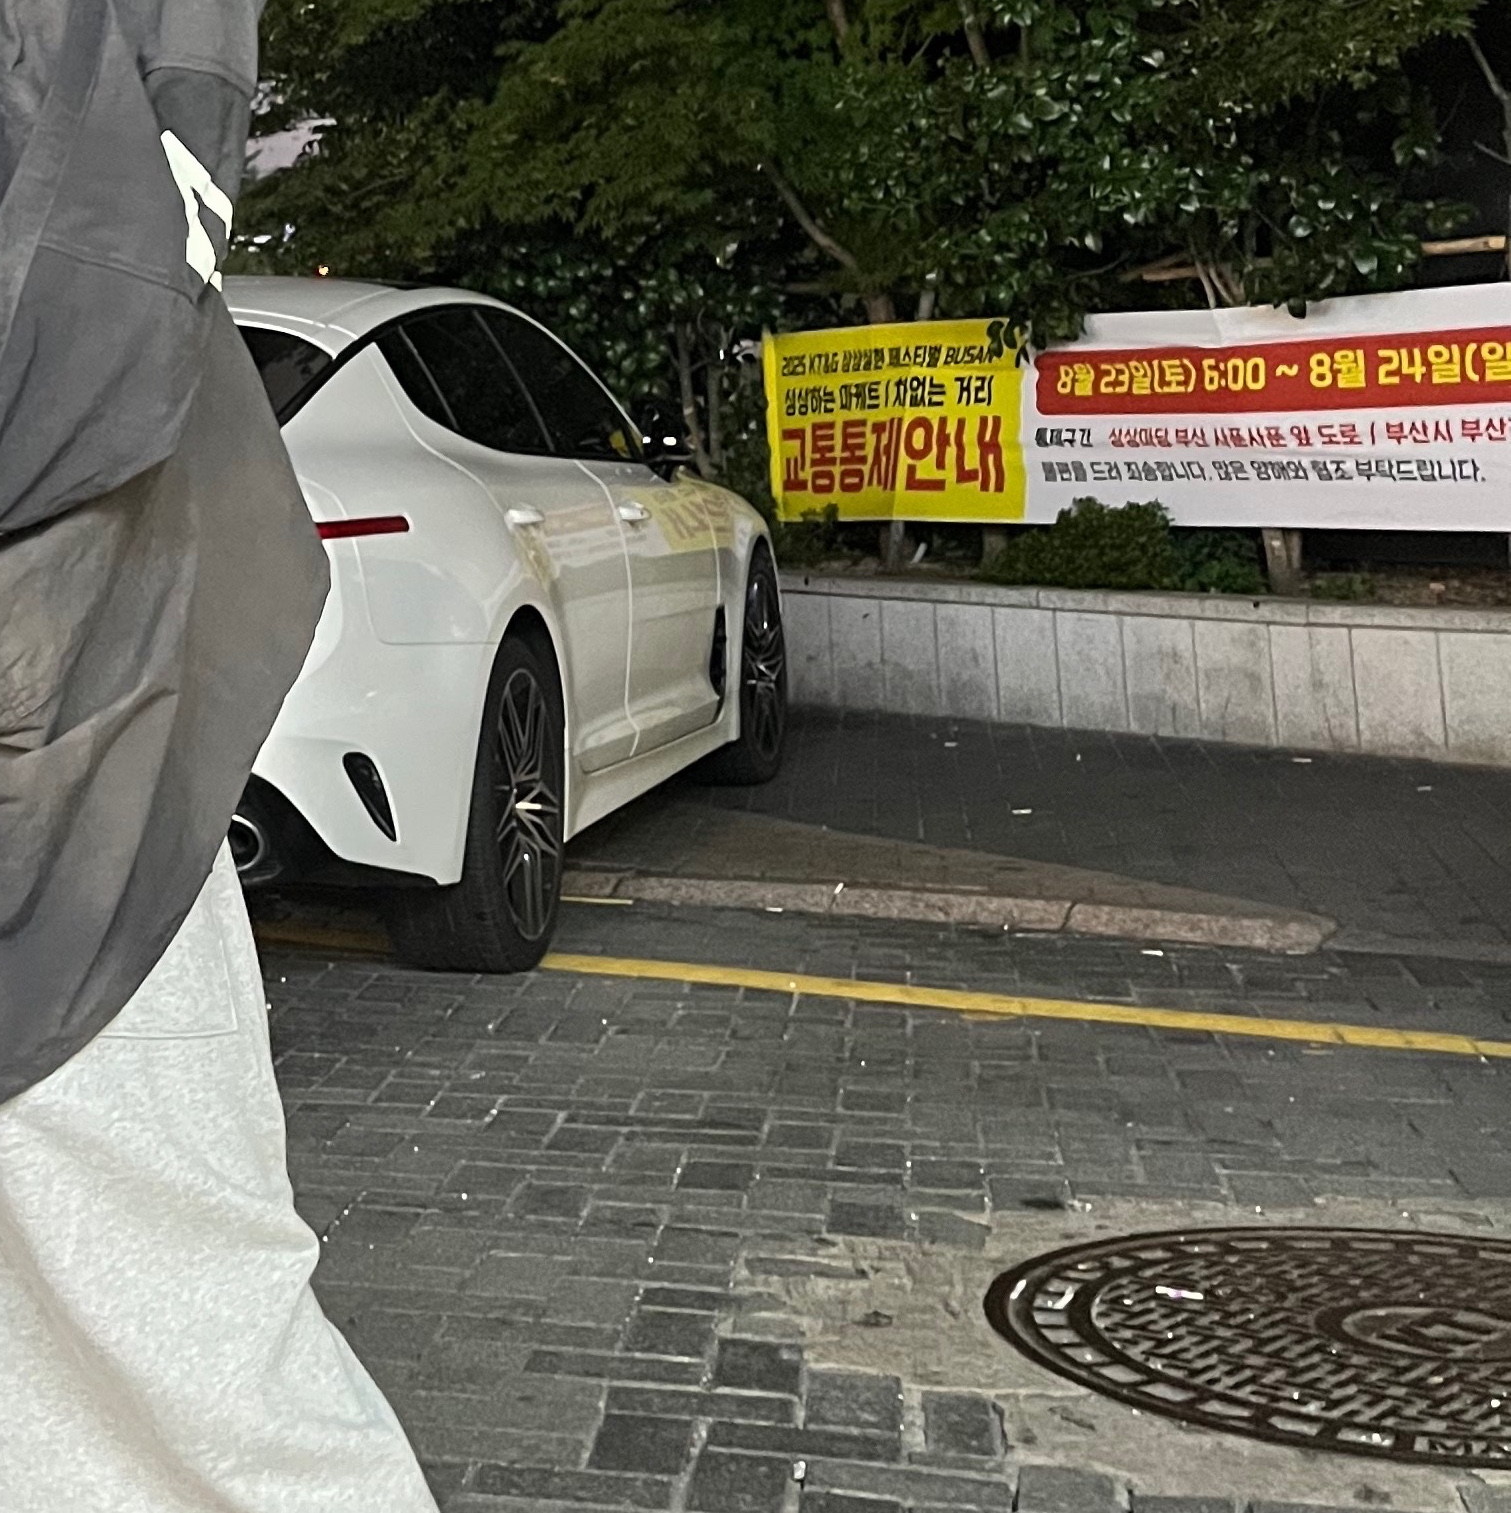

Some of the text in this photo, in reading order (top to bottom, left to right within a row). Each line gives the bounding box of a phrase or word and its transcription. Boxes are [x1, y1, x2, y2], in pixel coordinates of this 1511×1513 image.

[1057, 364, 1094, 396] 8월
[1100, 358, 1196, 395] 23일(토)
[1203, 357, 1265, 392] 6:00
[1309, 349, 1366, 388] 8월
[785, 385, 836, 416] 상상하는
[954, 375, 994, 406] 거리
[1175, 426, 1209, 448] 부산
[1317, 423, 1363, 445] 도로
[1386, 419, 1456, 445] 부산시
[1461, 417, 1511, 443] 부산
[782, 415, 1005, 494] 교통통제안내
[1355, 458, 1486, 482] 부탁드립니다.
